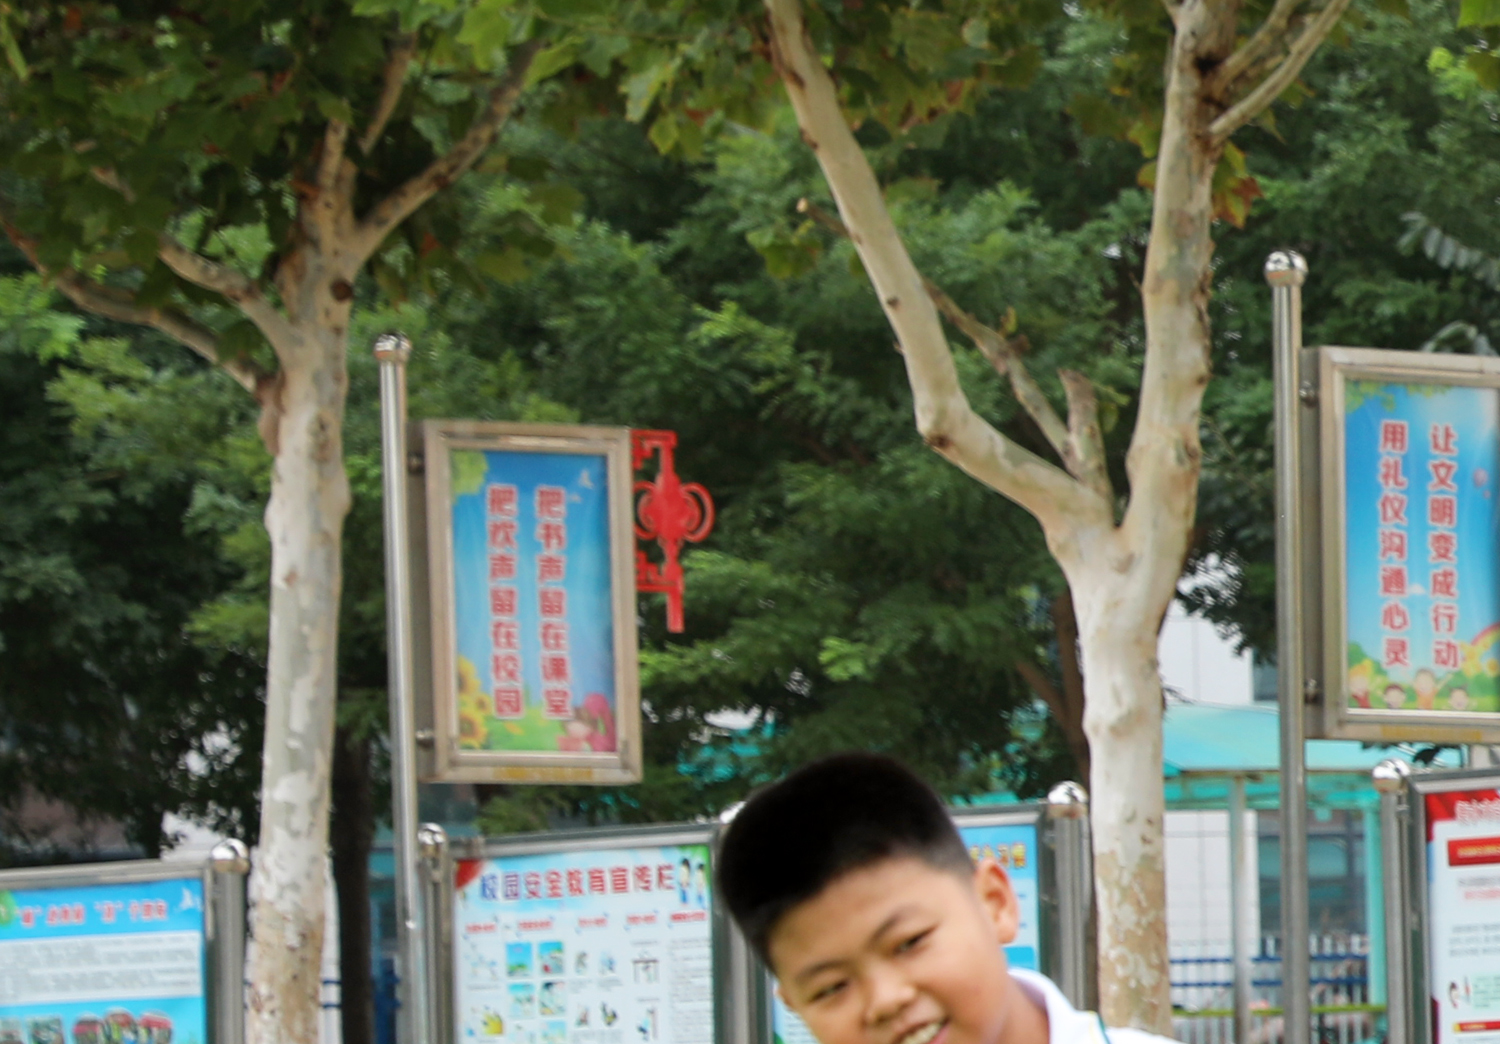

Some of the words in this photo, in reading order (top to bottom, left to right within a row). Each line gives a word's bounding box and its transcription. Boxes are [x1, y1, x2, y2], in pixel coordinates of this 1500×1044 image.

[1378, 420, 1410, 668] 用礼仪沟通心灵
[1428, 425, 1461, 669] 让文明变成行动
[480, 864, 675, 901] 校园安全教育宣传栏
